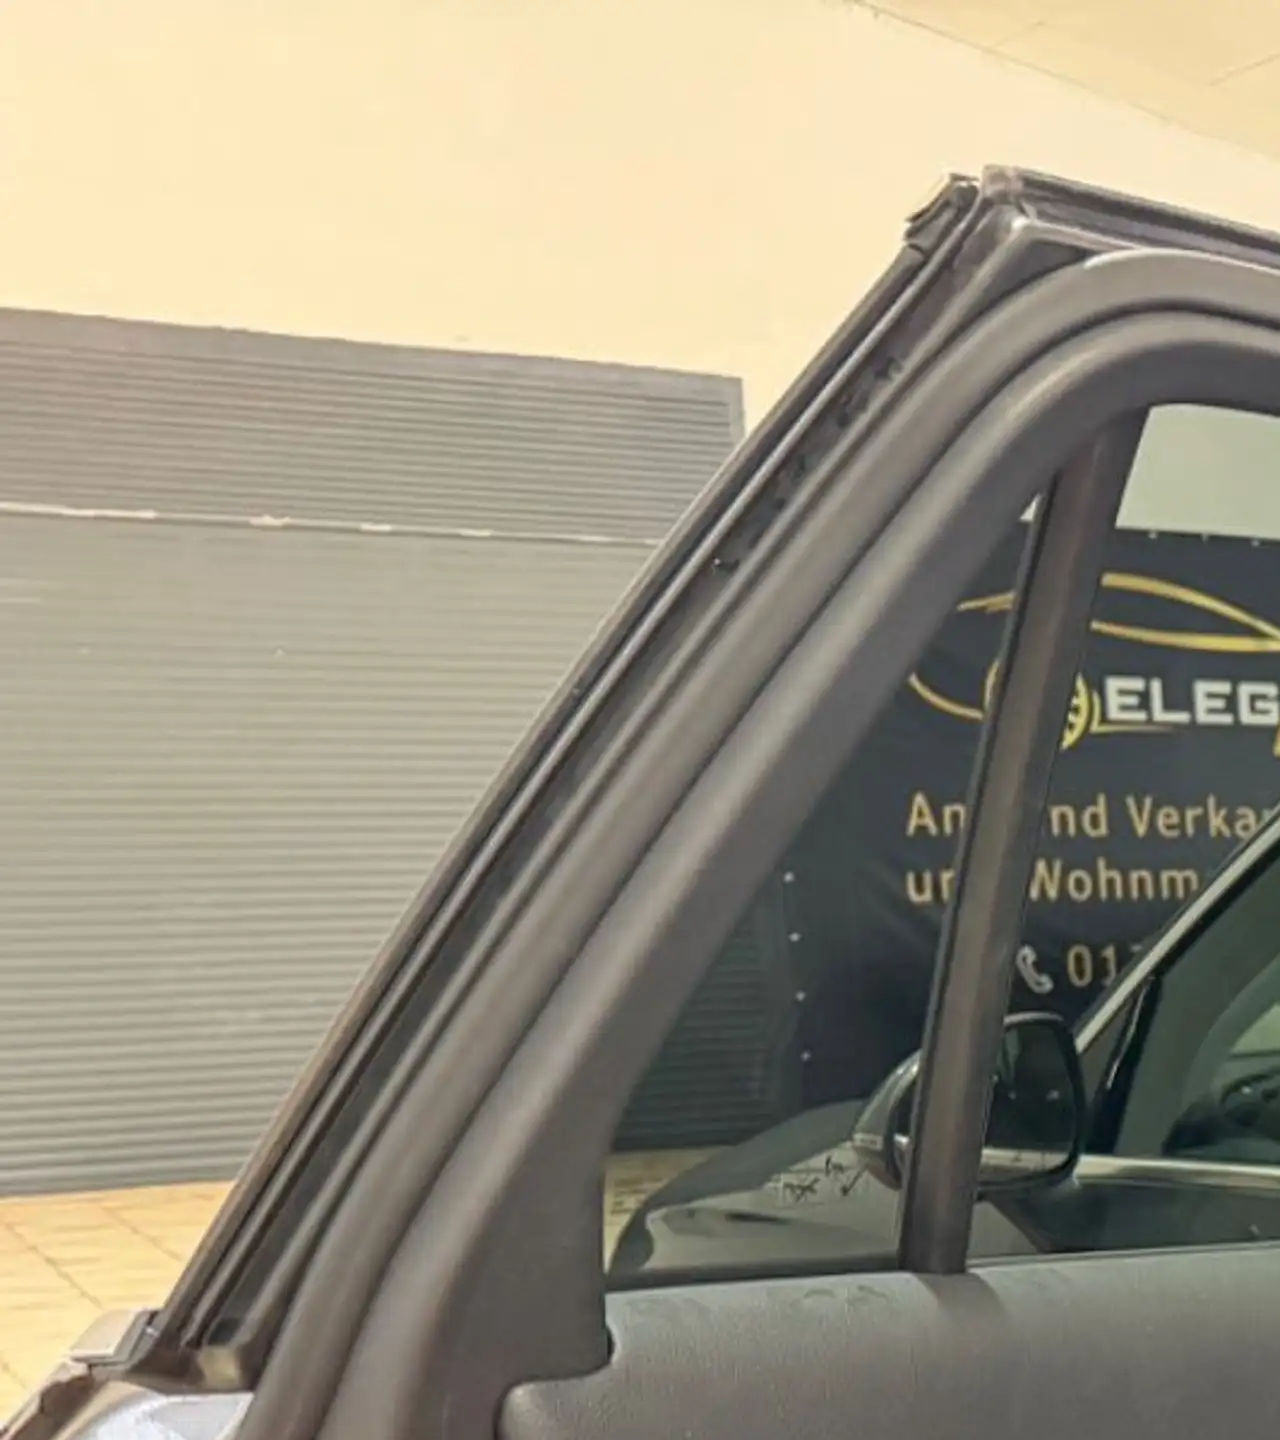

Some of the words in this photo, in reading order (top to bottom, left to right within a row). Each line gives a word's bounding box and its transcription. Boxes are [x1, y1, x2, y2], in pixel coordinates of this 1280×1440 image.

[1050, 792, 1110, 838] nd
[1126, 793, 1272, 840] Verka
[1030, 857, 1199, 904] Wohnm
[1067, 944, 1143, 987] 01
